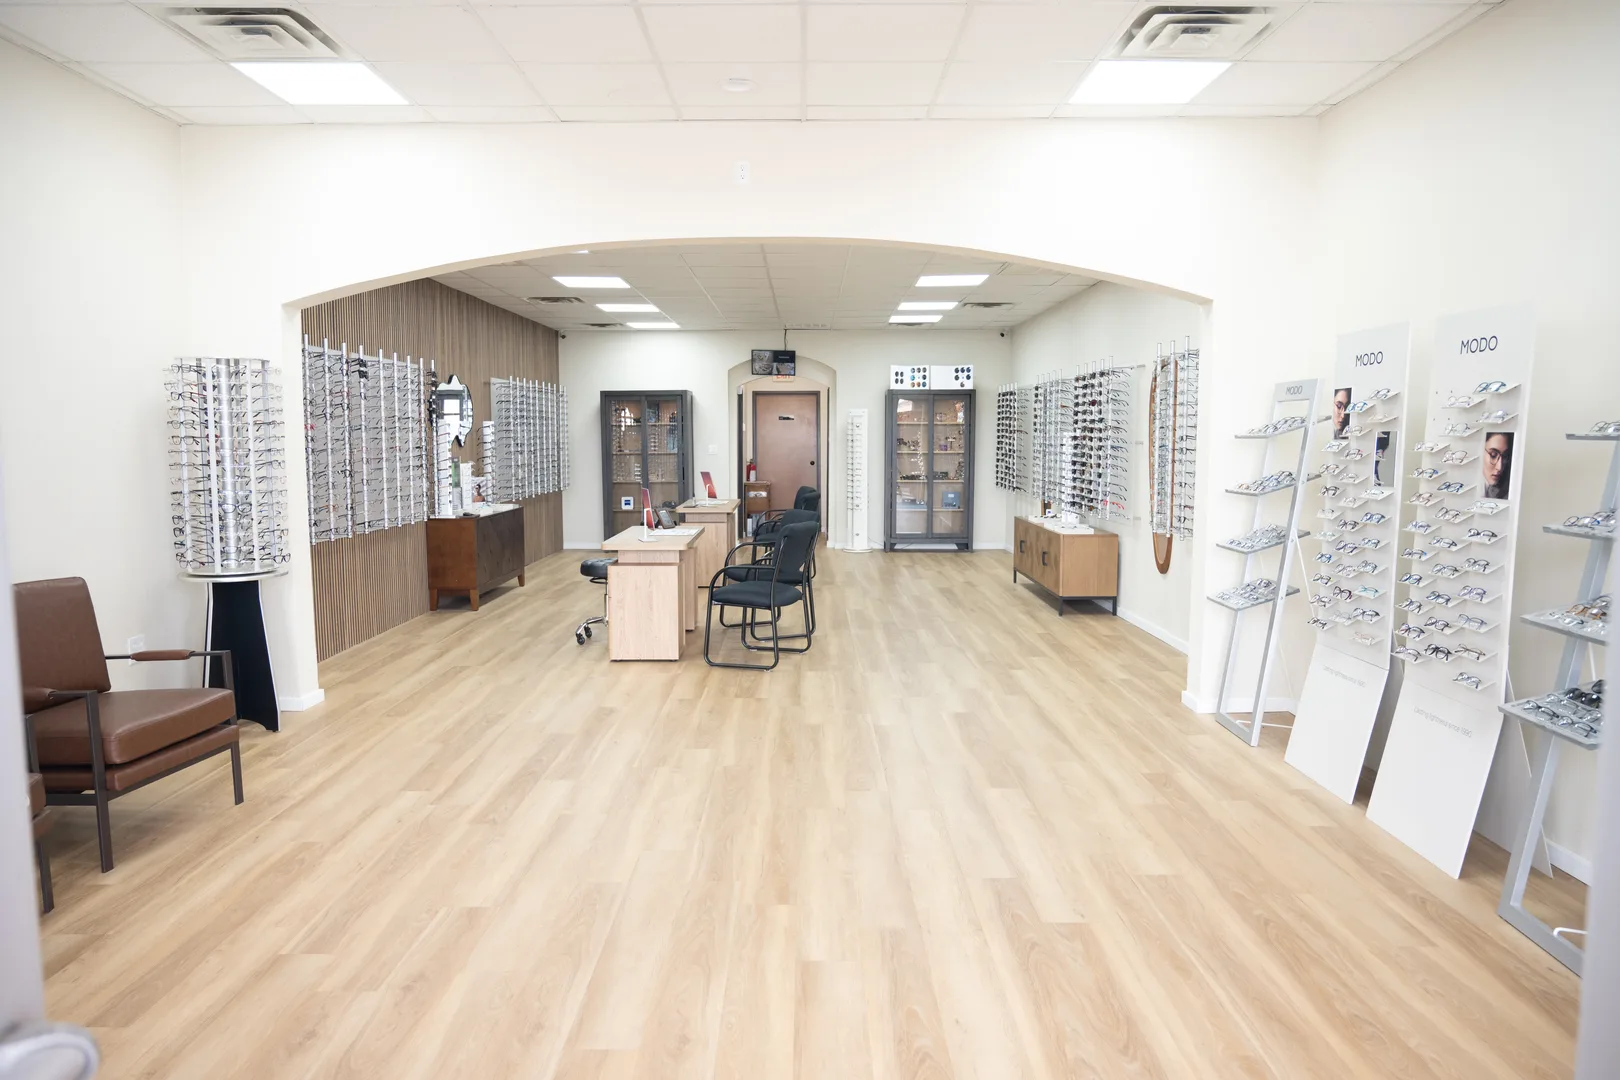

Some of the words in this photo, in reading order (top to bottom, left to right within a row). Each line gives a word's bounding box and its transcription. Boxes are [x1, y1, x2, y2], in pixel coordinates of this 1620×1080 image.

[1460, 335, 1498, 355] MODO
[1355, 351, 1384, 368] MODO
[1285, 385, 1303, 396] MODO
